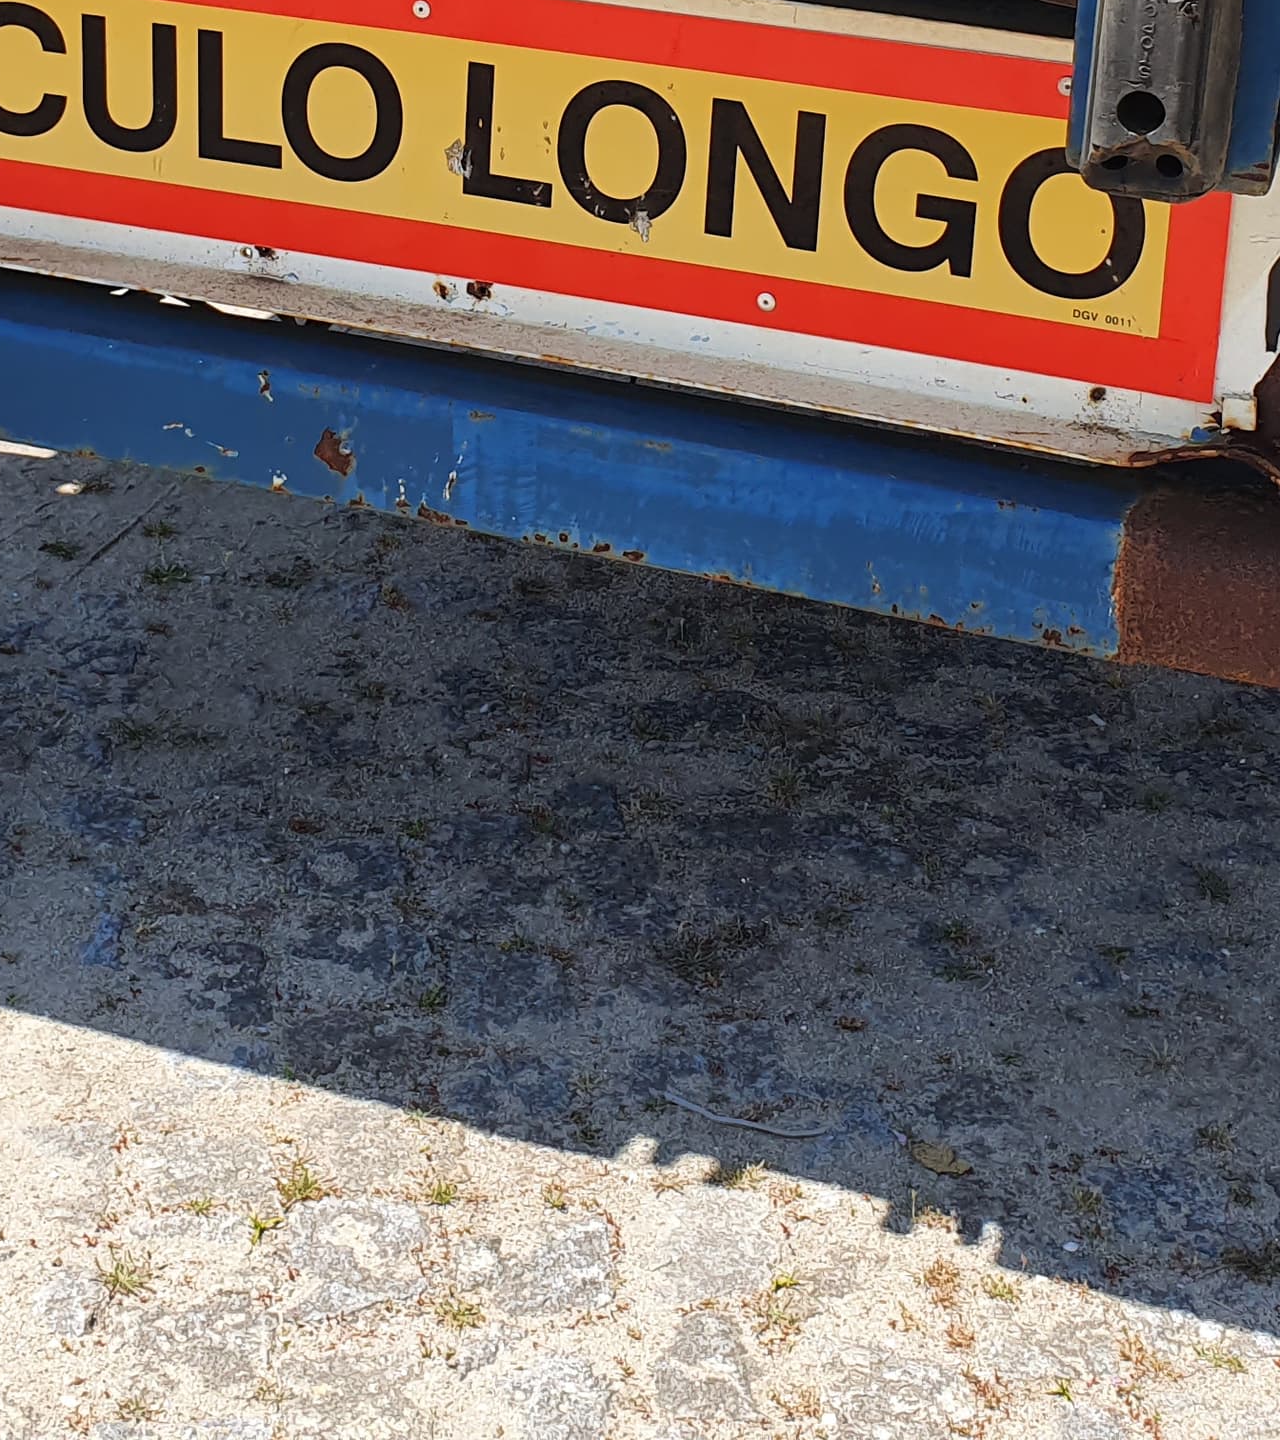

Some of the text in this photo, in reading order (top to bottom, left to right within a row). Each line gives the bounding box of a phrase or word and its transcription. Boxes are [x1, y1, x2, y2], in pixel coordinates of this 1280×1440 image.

[462, 60, 1146, 300] LONGO
[1072, 308, 1131, 327] DGV 0011
